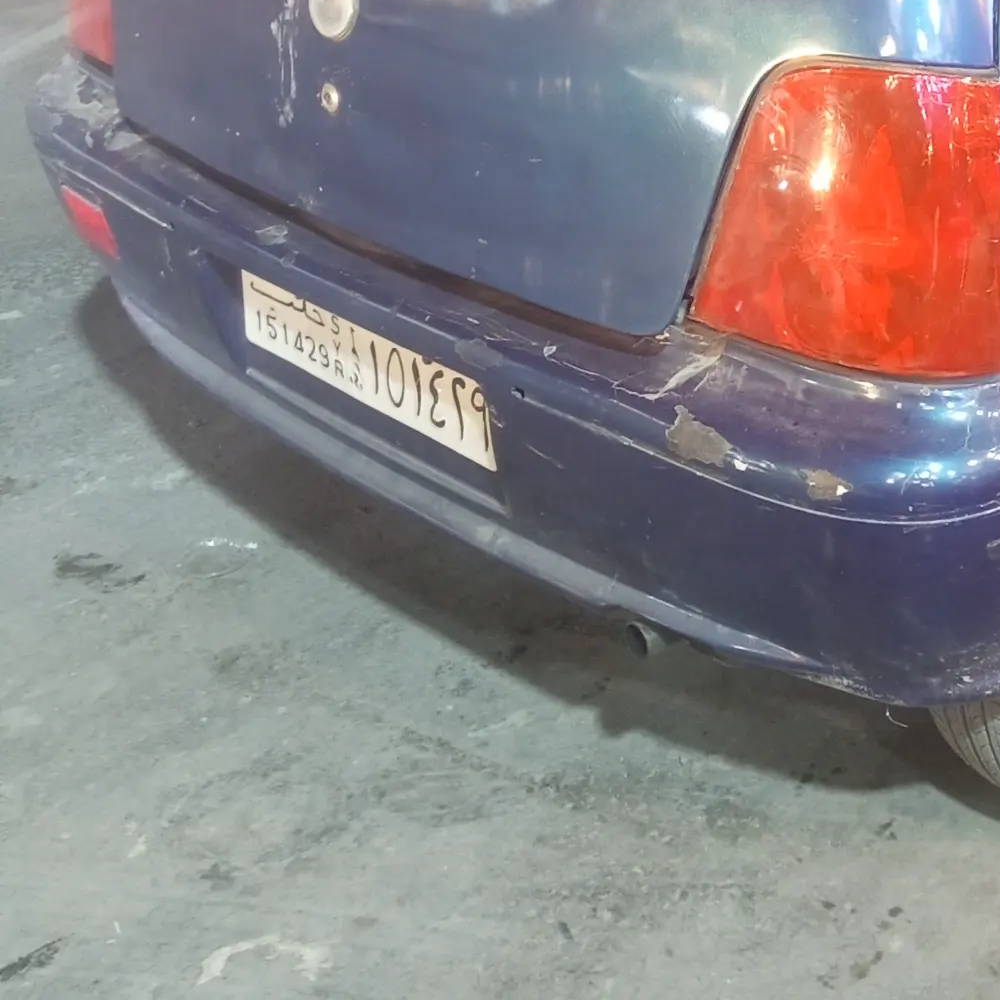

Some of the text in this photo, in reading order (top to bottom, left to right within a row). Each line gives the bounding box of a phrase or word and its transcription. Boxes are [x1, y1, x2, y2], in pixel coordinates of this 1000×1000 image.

[250, 281, 326, 327] حلب
[256, 309, 331, 368] 151429
[329, 314, 346, 381] SYR
[369, 339, 491, 453] ١٥١٤٢٩
